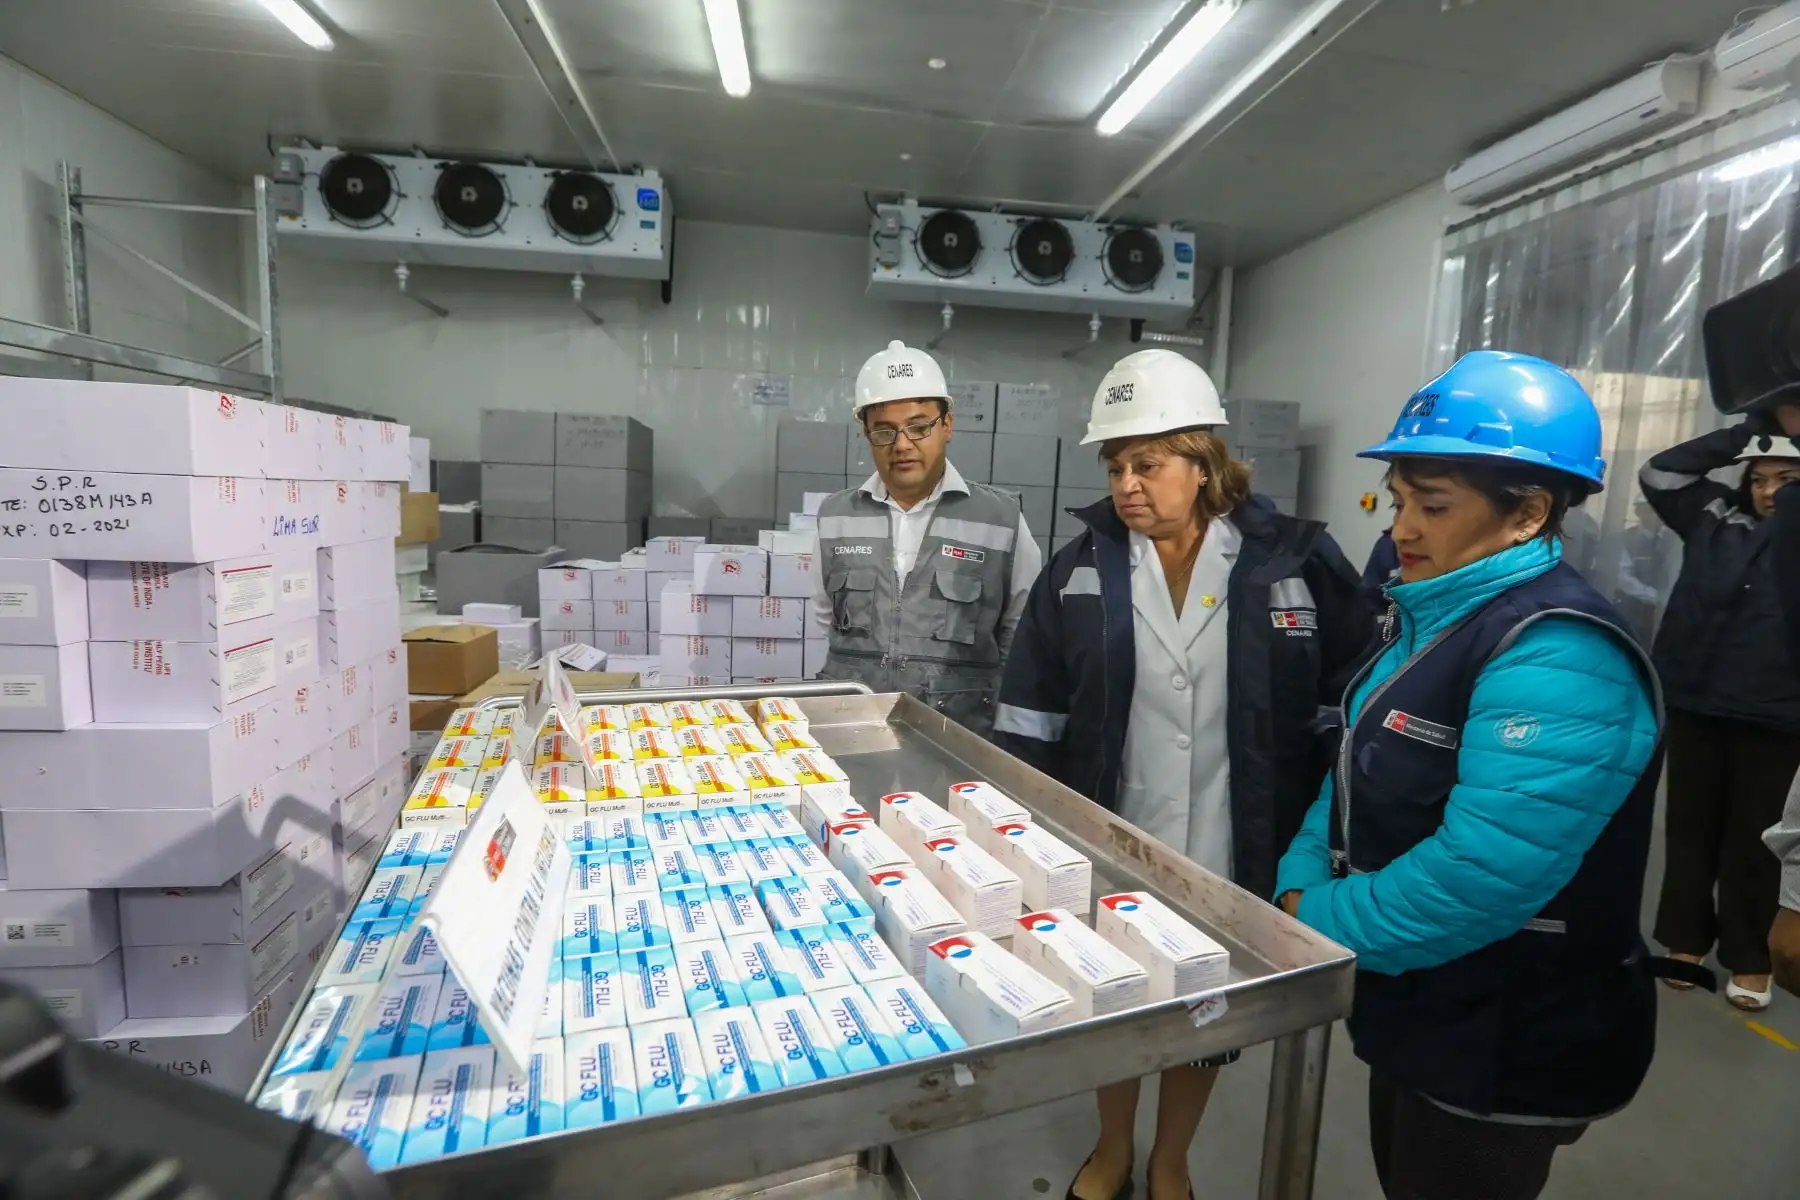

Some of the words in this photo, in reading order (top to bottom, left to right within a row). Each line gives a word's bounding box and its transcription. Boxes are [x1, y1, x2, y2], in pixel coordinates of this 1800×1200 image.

[888, 364, 913, 379] CENARES
[1105, 383, 1133, 406] CENARES
[302, 514, 320, 534] SUR
[834, 546, 873, 555] CENARES
[573, 825, 583, 834] FLU
[614, 823, 623, 832] FLU
[397, 837, 410, 848] FLU
[444, 834, 457, 845] FLU
[573, 834, 584, 842] GC
[614, 831, 625, 840] GC
[392, 848, 406, 856] GC
[440, 844, 453, 852] GC
[759, 847, 770, 855] GC
[798, 843, 809, 852] GC
[804, 851, 820, 862] FLU
[664, 856, 675, 867] FLU
[719, 851, 729, 861] GC
[764, 855, 777, 865] FLU
[590, 863, 600, 871] GC
[634, 859, 645, 868] GC
[723, 861, 736, 871] FLU
[590, 872, 601, 884] FLU
[636, 868, 648, 880] FLU
[666, 866, 680, 876] GC
[375, 881, 392, 895] FLU
[789, 887, 802, 897] GC
[818, 884, 834, 898] FLU
[370, 894, 385, 905] GC
[689, 901, 702, 911] GC
[735, 894, 748, 905] GC
[795, 896, 812, 910] FLU
[827, 896, 842, 906] GC
[625, 907, 639, 921] FLU
[692, 911, 707, 925] FLU
[739, 905, 755, 918] FLU
[574, 912, 587, 926] FLU
[574, 926, 588, 939] GC
[627, 921, 641, 933] GC
[367, 933, 385, 946] GC
[857, 933, 874, 945] GC
[866, 945, 886, 961] FLU
[358, 946, 379, 965] FLU
[742, 951, 758, 967] FLU
[808, 940, 824, 953] GC
[816, 953, 835, 969] FLU
[651, 964, 666, 978] GC
[688, 960, 705, 977] FLU
[750, 967, 767, 981] GC
[595, 972, 609, 986] GC
[695, 977, 711, 991] GC
[655, 979, 671, 998] FLU
[451, 989, 469, 1010] FLU
[596, 986, 611, 1007] FLU
[384, 997, 403, 1020] FLU
[888, 999, 911, 1018] FLU
[448, 1009, 467, 1026] GC
[831, 1009, 854, 1029] FLU
[376, 1020, 396, 1036] GC
[774, 1022, 796, 1042] FLU
[903, 1019, 923, 1035] GC
[713, 1034, 736, 1055] FLU
[844, 1029, 864, 1046] GC
[649, 1045, 668, 1069] FLU
[784, 1043, 804, 1061] GC
[580, 1056, 598, 1081] FLU
[720, 1056, 737, 1075] GC
[652, 1070, 672, 1089] GC
[430, 1078, 453, 1107] FLU
[580, 1081, 599, 1102] GC
[347, 1090, 373, 1119] FLU
[505, 1095, 525, 1117] GC
[425, 1108, 447, 1131] GC
